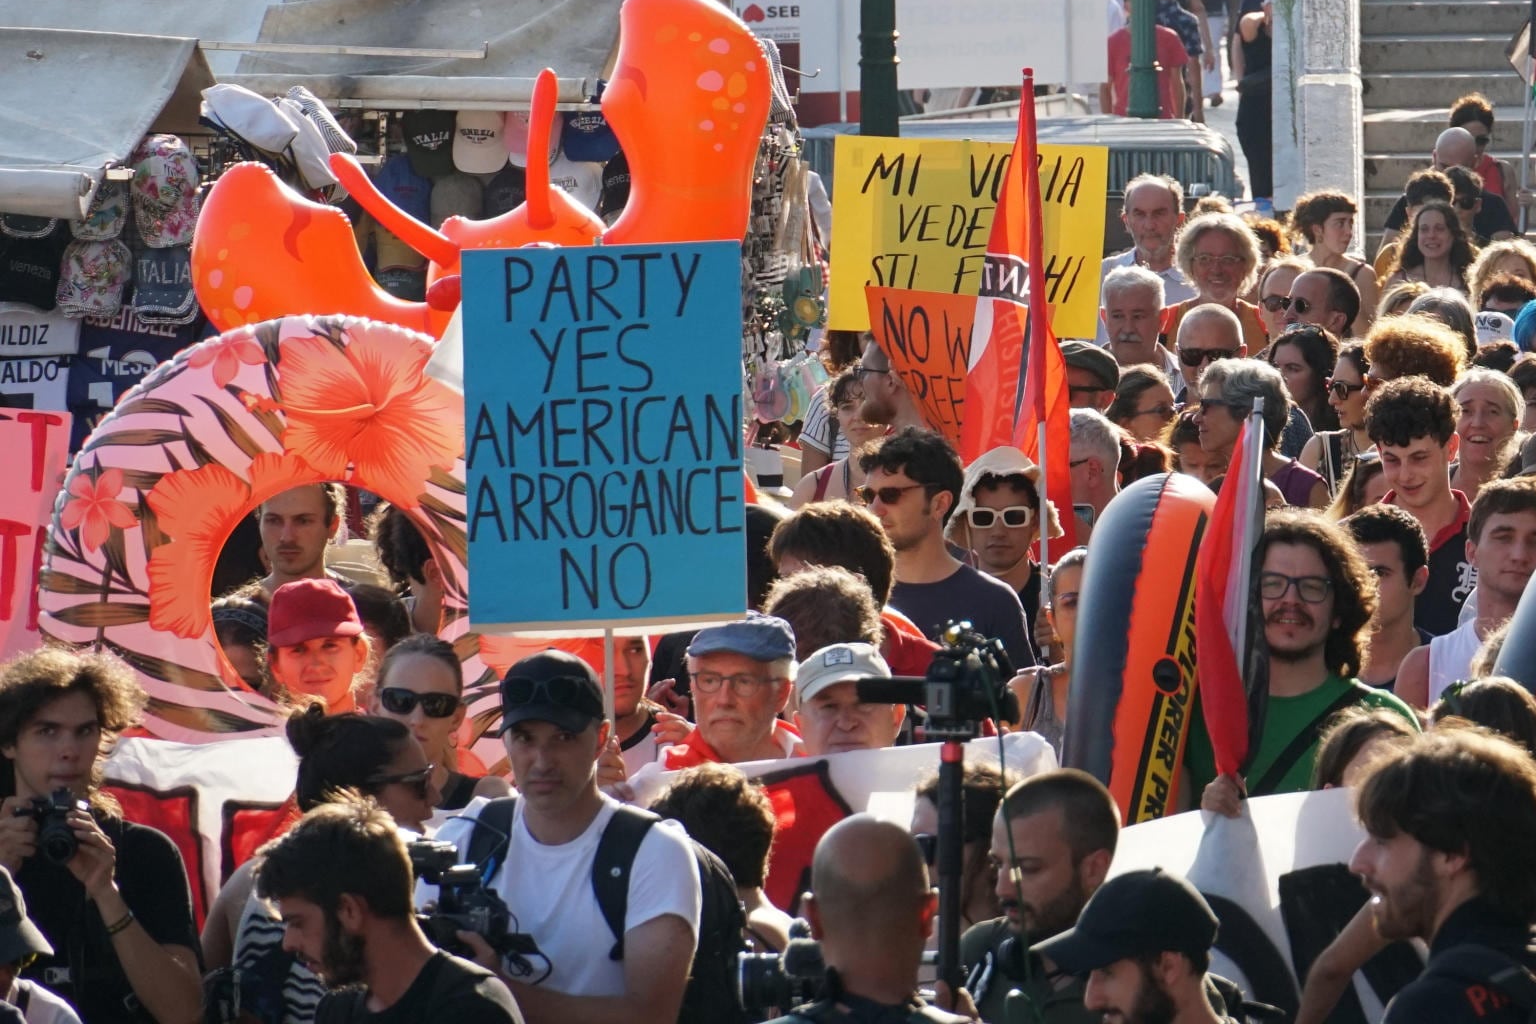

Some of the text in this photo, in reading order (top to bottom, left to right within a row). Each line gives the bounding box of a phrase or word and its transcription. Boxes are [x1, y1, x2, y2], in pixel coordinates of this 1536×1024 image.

[767, 5, 800, 18] SEB
[412, 131, 450, 145] ITALIA
[861, 153, 922, 197] MI
[899, 204, 995, 250] VEDE
[138, 259, 191, 285] ITALIA
[504, 252, 702, 323] PARTY
[866, 253, 918, 290] STI
[0, 324, 48, 346] ILDIZ
[881, 296, 930, 364] NO
[1, 360, 59, 384] ALDO
[101, 359, 153, 376] MESS
[530, 323, 654, 394] YES
[466, 393, 741, 470] AMERICAN
[469, 465, 742, 543] ARROGANCE
[559, 541, 653, 610] NO
